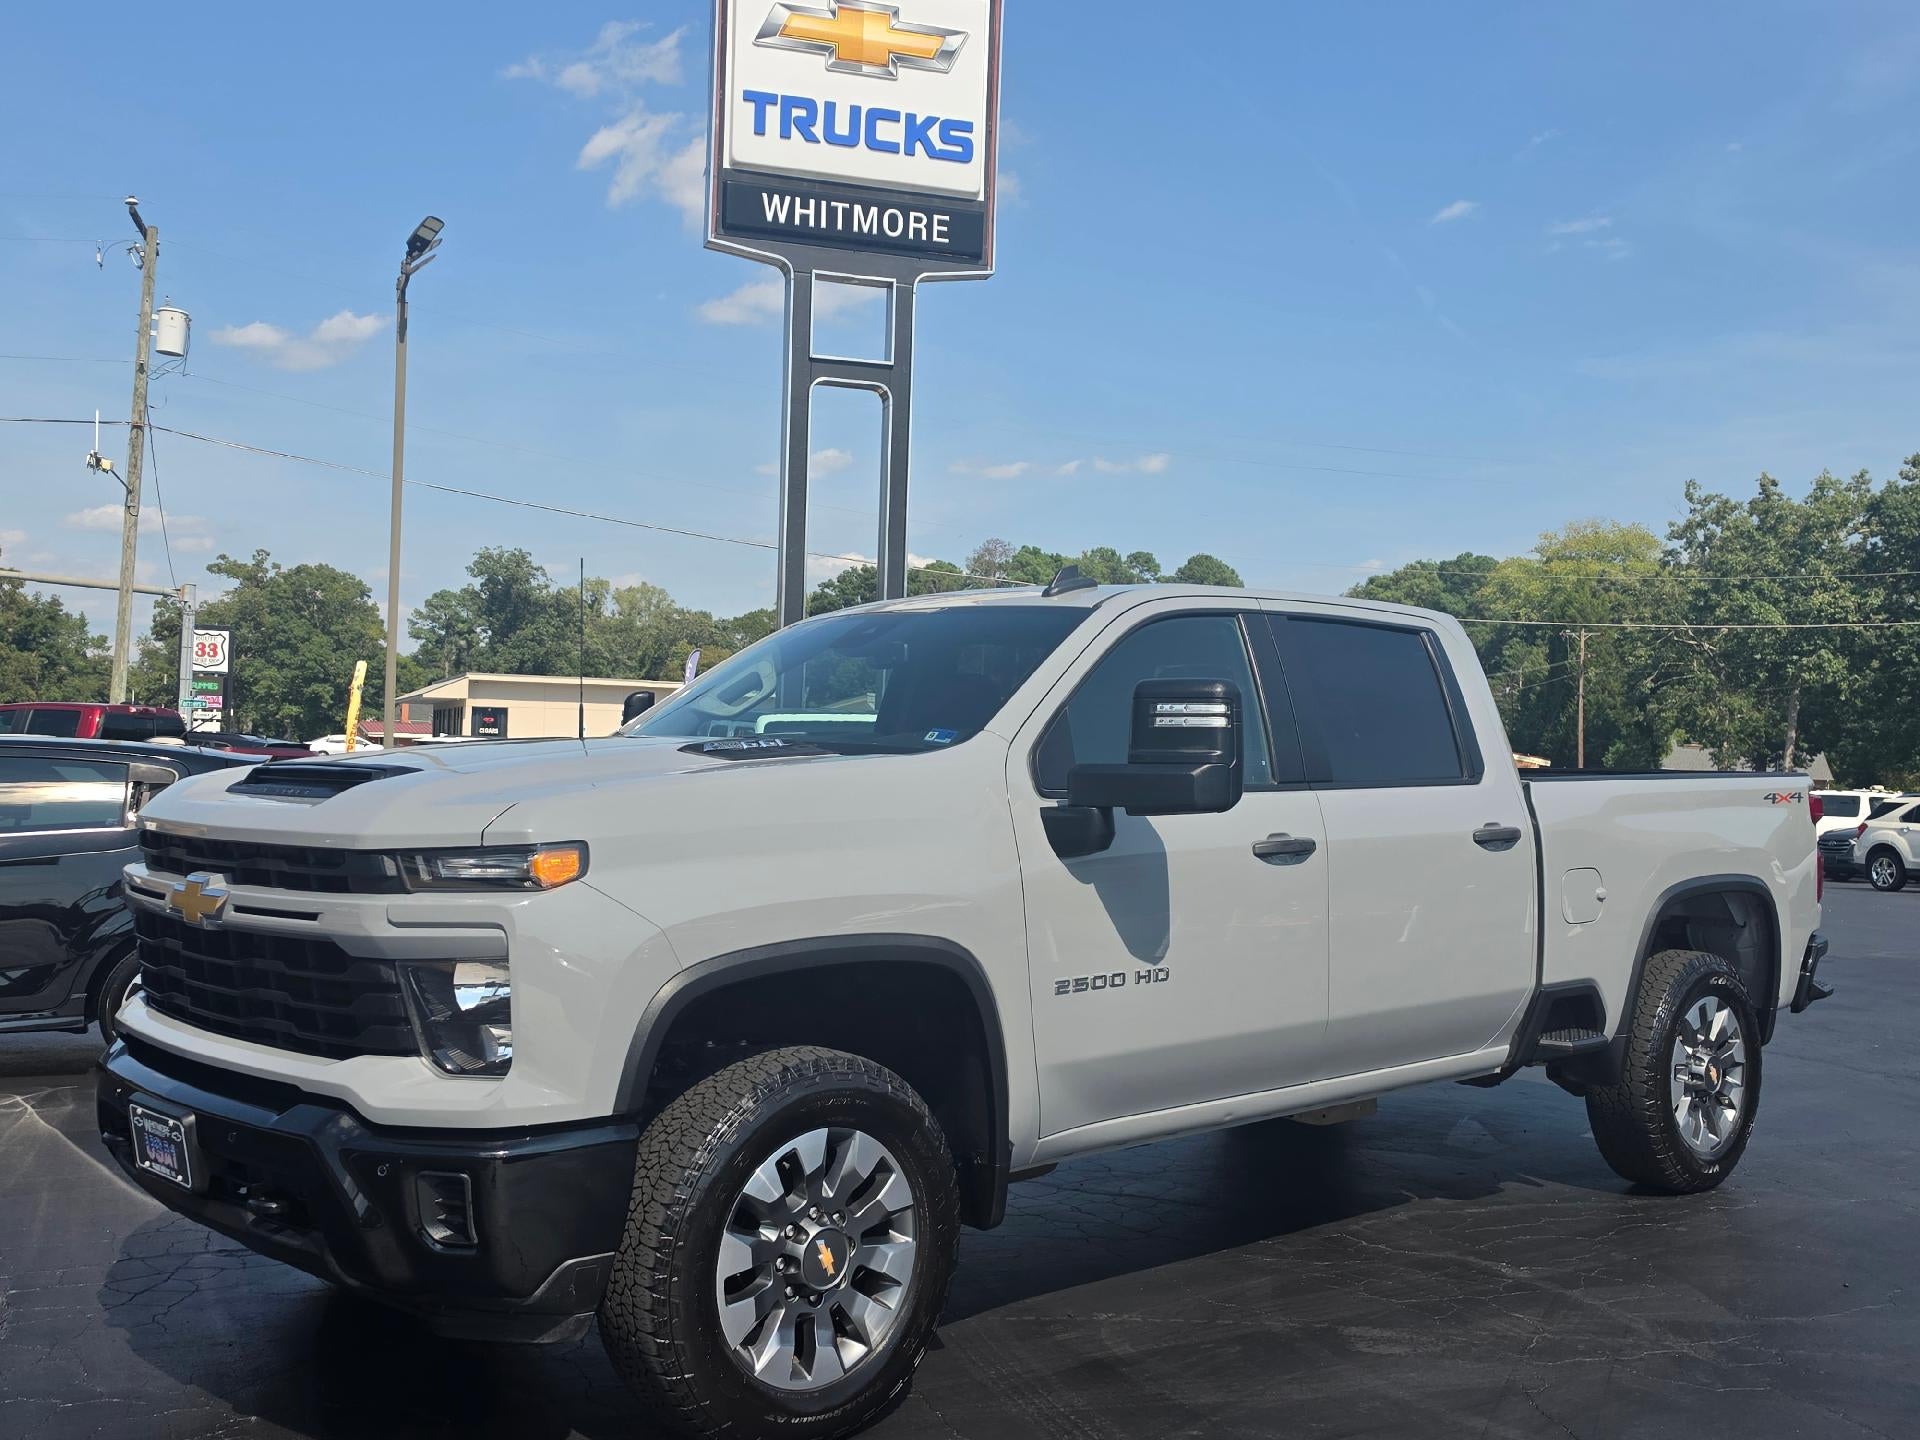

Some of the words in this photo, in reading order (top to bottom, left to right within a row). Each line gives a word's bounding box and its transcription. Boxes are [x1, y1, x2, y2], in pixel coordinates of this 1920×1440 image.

[743, 89, 974, 163] TRUCKS
[761, 192, 950, 243] WHITMORE
[195, 642, 218, 657] 33
[1054, 972, 1126, 996] 2500
[1134, 967, 1170, 985] HD
